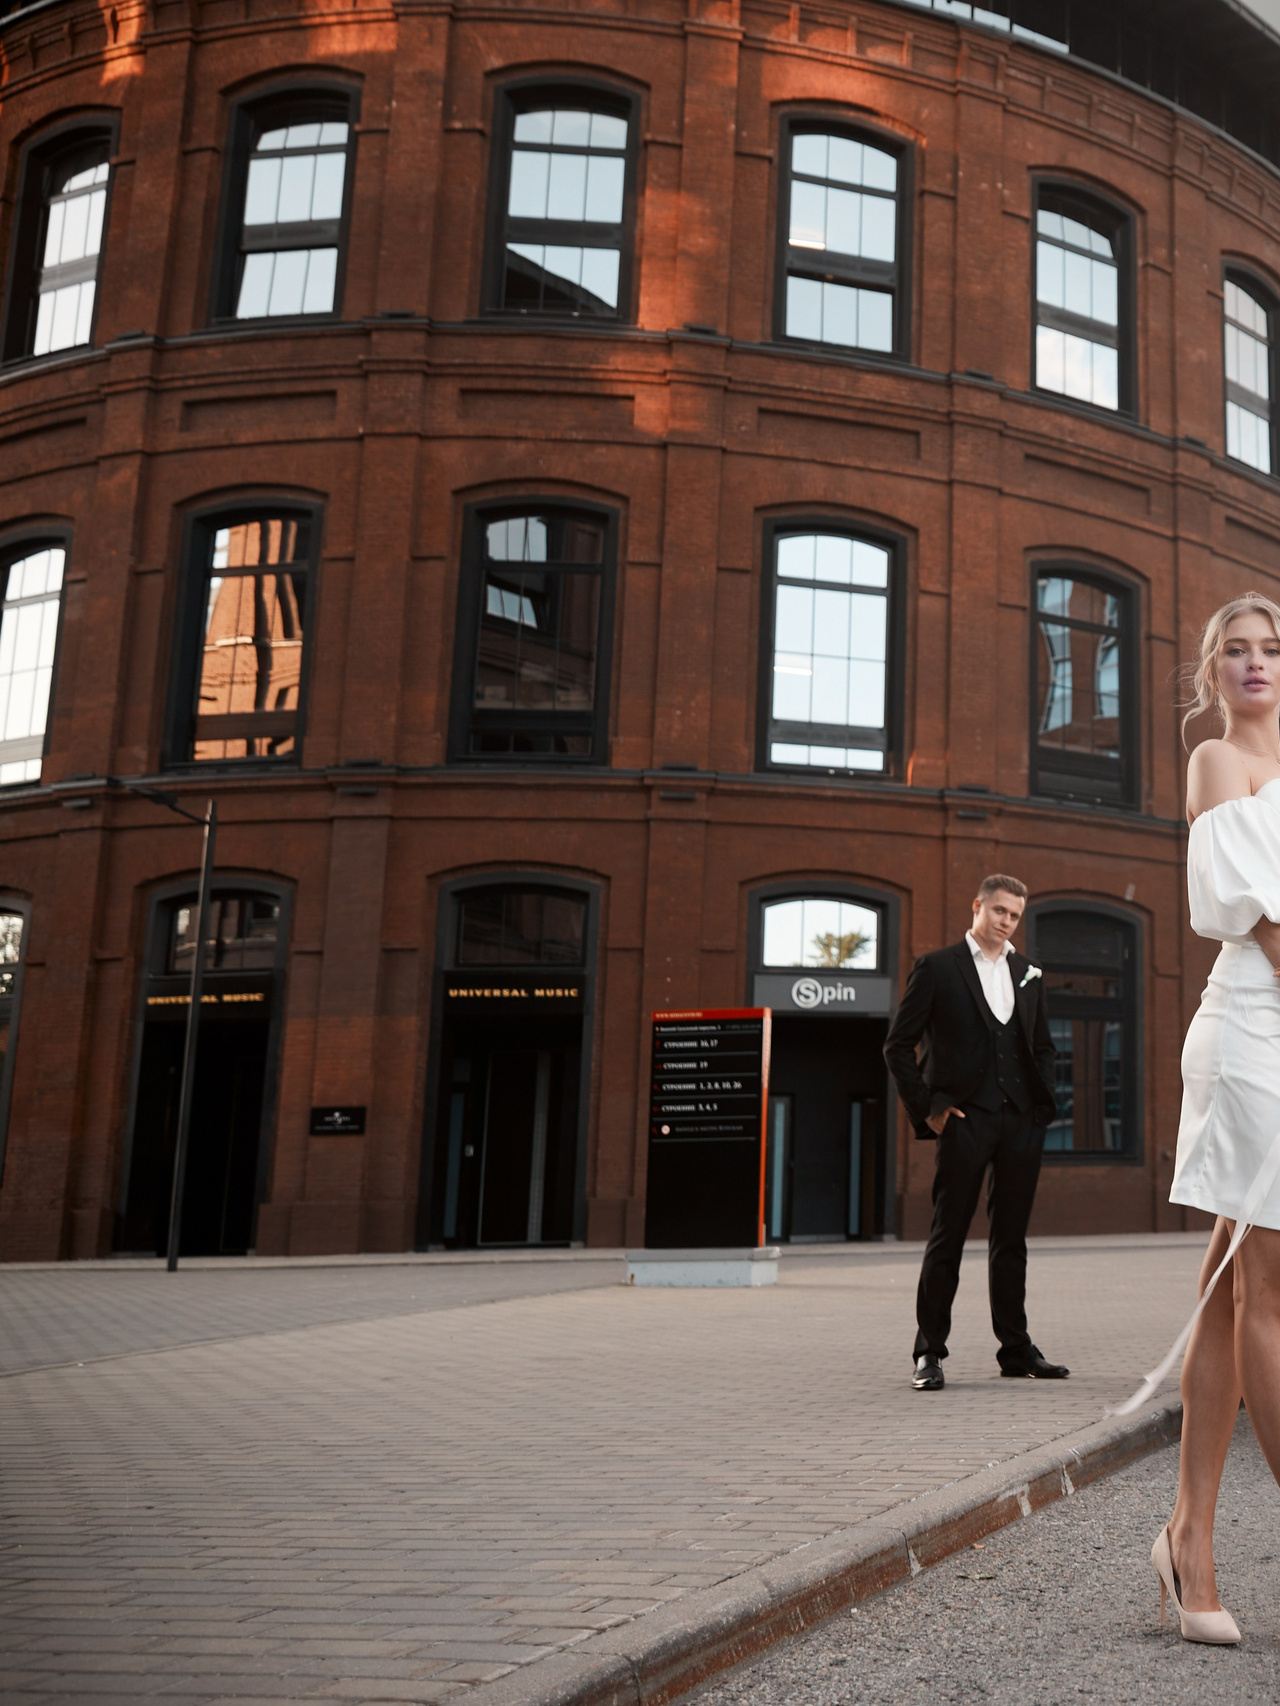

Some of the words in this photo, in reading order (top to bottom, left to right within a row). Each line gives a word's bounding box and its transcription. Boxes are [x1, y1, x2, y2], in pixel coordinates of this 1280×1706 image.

[147, 995, 219, 1005] UNIVERAL
[222, 992, 264, 1002] MUSIC
[448, 988, 529, 998] UNIVERSAL
[534, 988, 579, 998] MUSIC
[791, 977, 856, 1009] Spin
